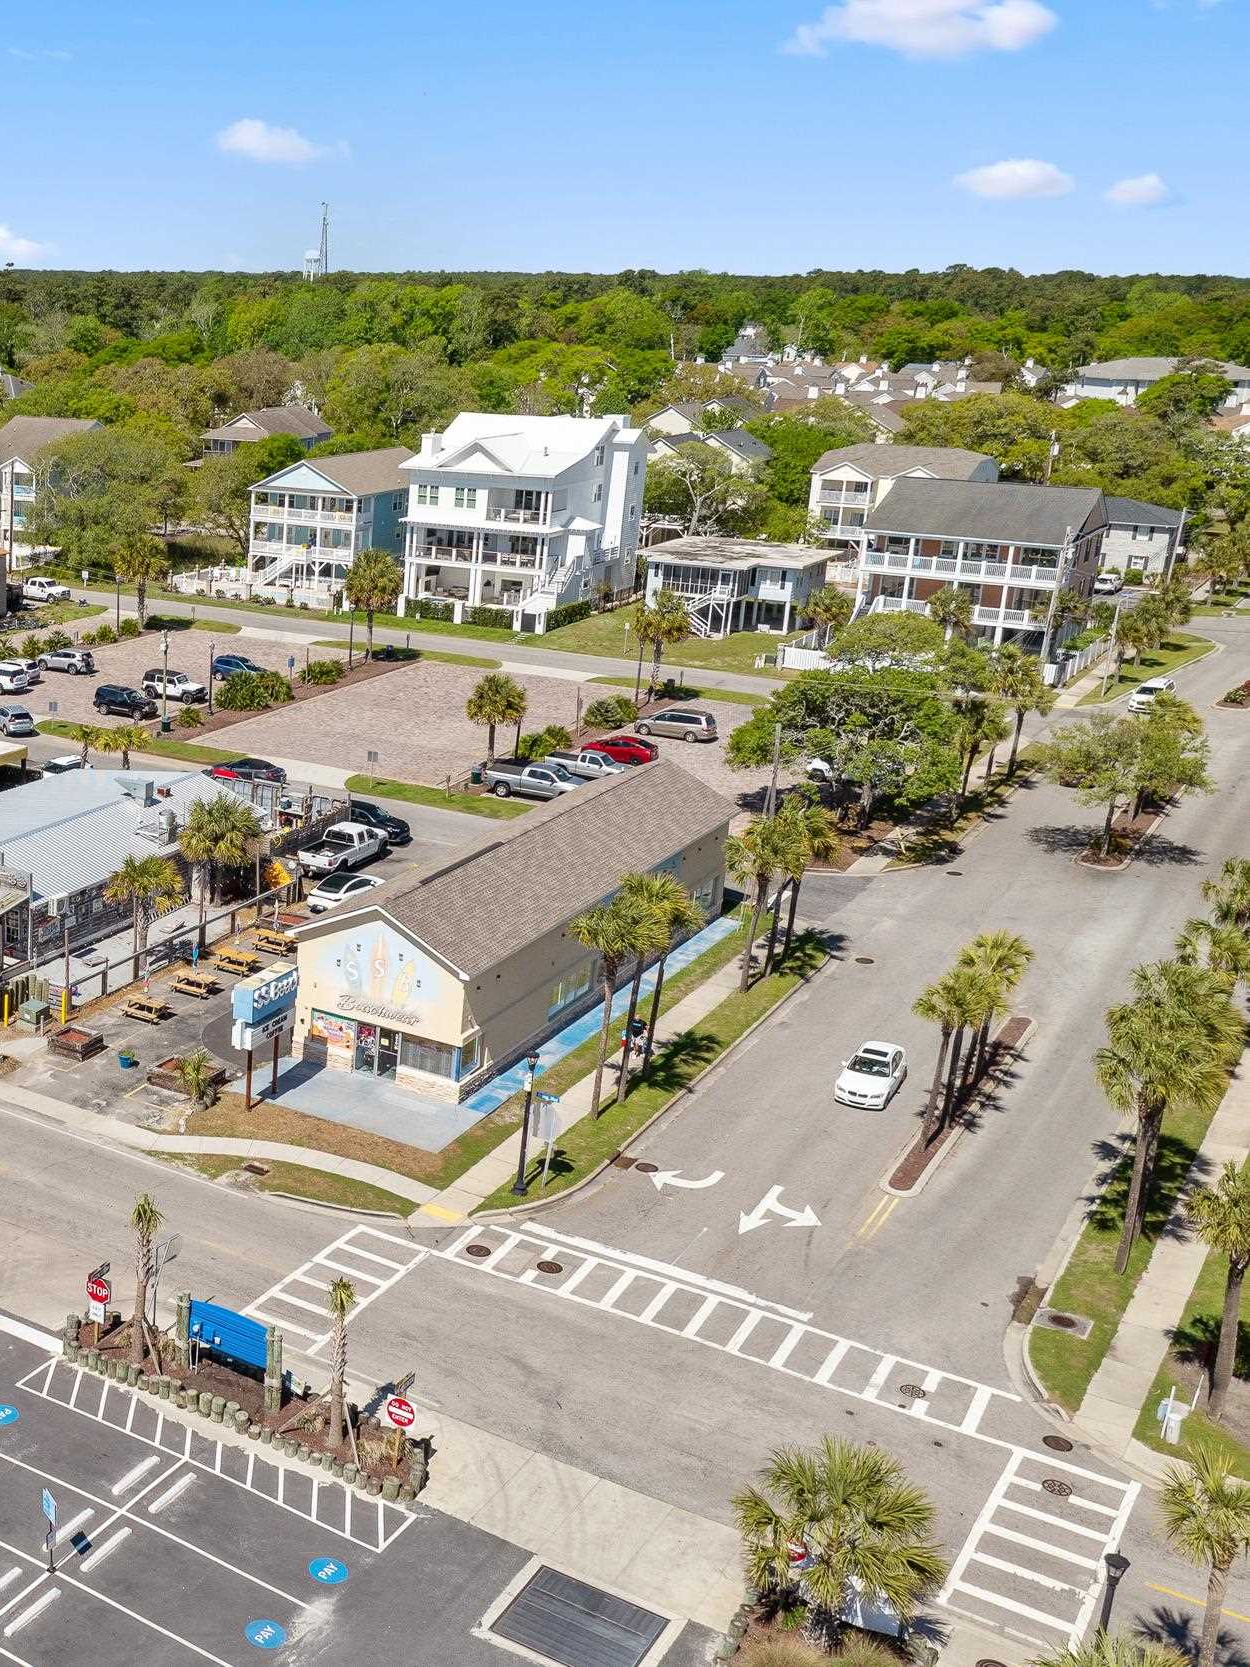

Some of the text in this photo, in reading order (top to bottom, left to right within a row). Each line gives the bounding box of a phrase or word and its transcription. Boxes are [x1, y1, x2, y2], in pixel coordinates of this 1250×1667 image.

[336, 993, 421, 1025] Beachwear
[87, 1282, 108, 1299] STOP
[391, 1400, 412, 1413] DO NOT
[318, 1562, 338, 1580] PAY
[254, 1625, 276, 1644] PAY
